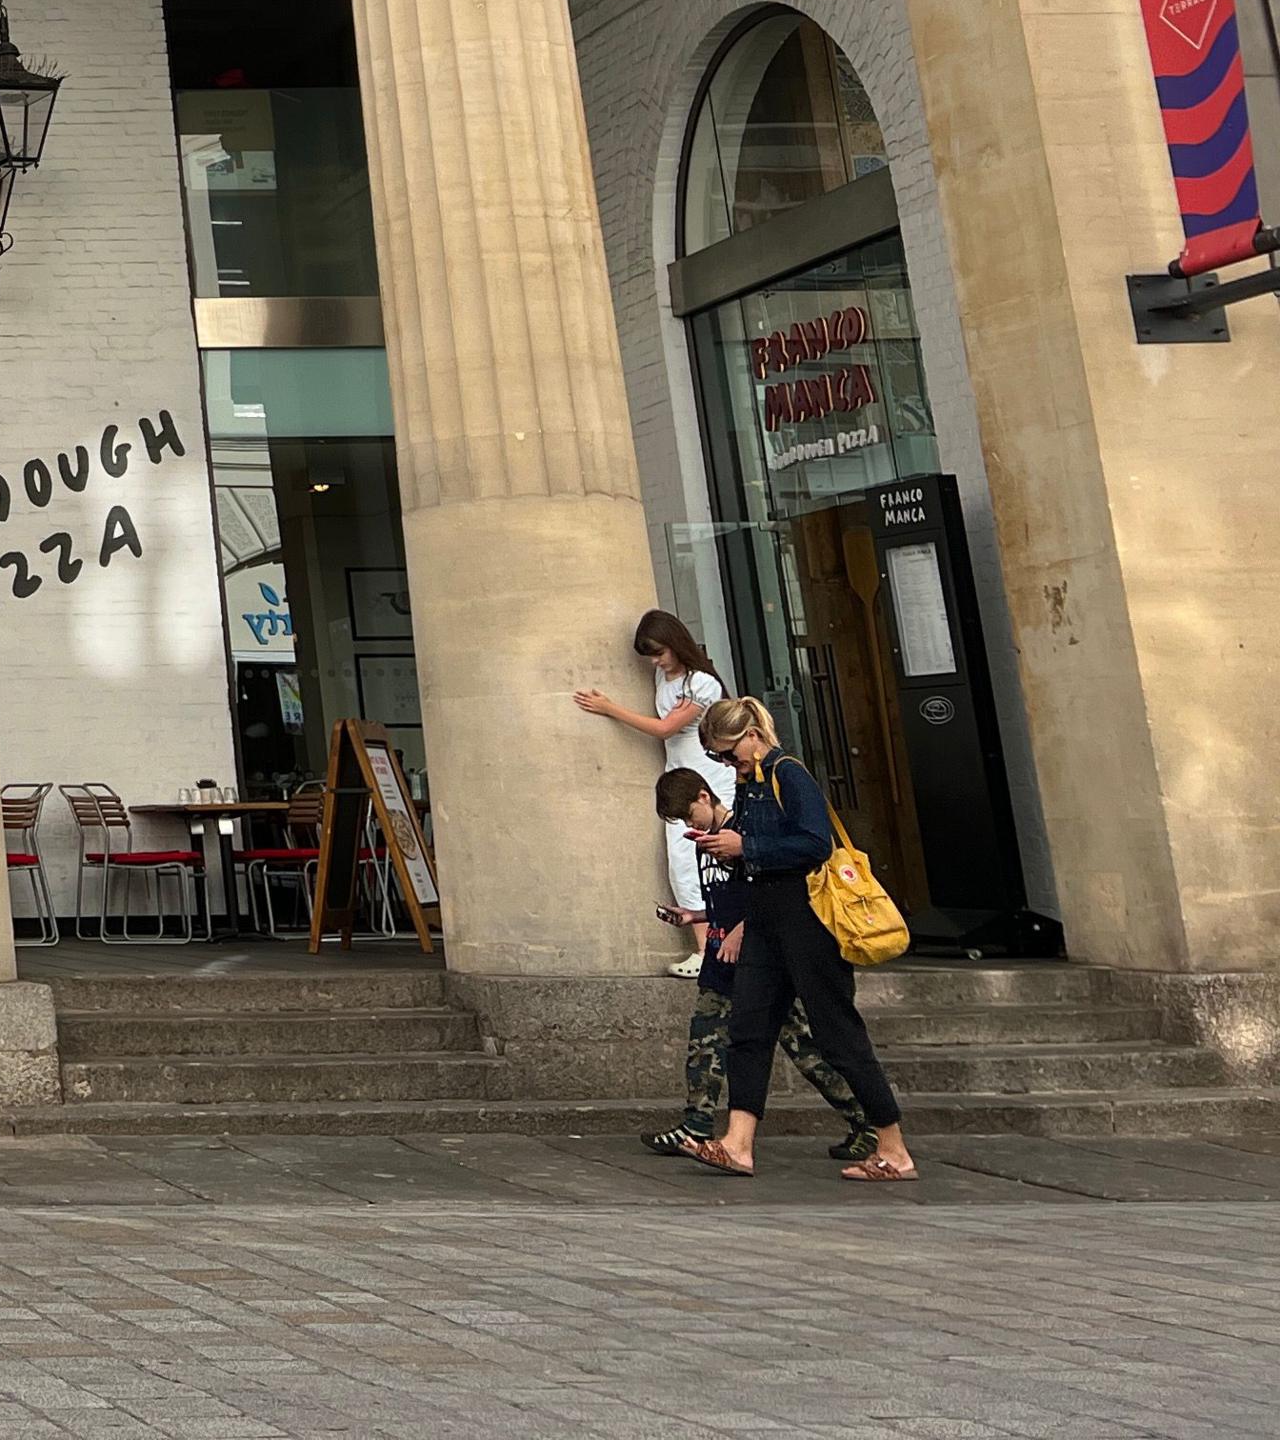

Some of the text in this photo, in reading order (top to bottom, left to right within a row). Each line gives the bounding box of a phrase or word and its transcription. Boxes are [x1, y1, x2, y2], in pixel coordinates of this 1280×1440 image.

[751, 306, 868, 380] FRANCO
[765, 365, 878, 433] MANCA
[836, 424, 880, 455] PIZZA
[880, 488, 923, 509] FRANCO
[884, 507, 926, 527] MANCA
